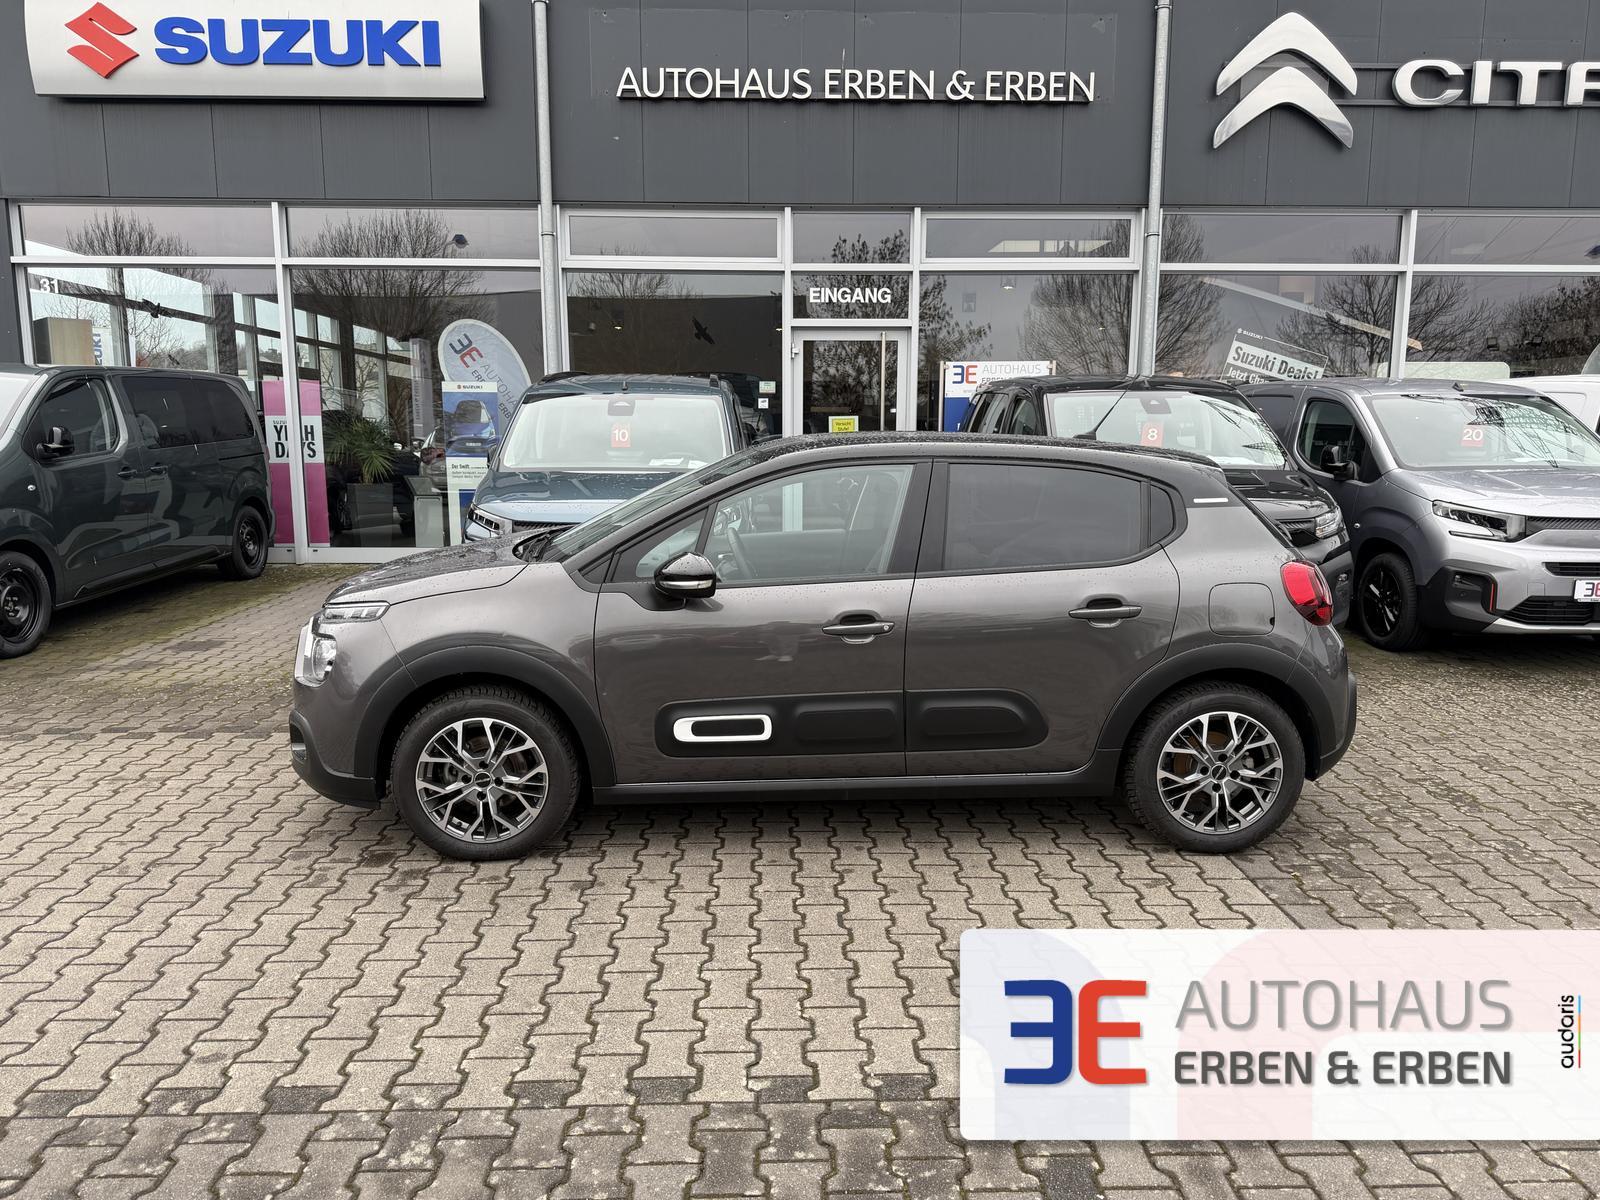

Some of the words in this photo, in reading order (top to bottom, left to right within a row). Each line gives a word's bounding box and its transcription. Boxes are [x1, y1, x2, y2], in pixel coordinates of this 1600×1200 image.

[154, 16, 441, 67] SUZUKI
[616, 67, 811, 99] AUTOHAUS
[824, 69, 934, 100] ERBEN
[946, 70, 975, 101] &
[985, 70, 1095, 102] ERBEN
[40, 278, 58, 293] 31
[809, 287, 892, 304] EINGANG
[983, 364, 1042, 375] AUTOHAUS
[1233, 346, 1276, 373] Suzuki
[1277, 360, 1318, 380] Deals!
[1227, 367, 1247, 382] Jetzt
[1249, 373, 1270, 385] Cha
[273, 425, 315, 441] YH
[613, 429, 628, 441] 10
[1147, 428, 1157, 440] 8
[1462, 429, 1483, 441] 20
[275, 442, 316, 458] DS
